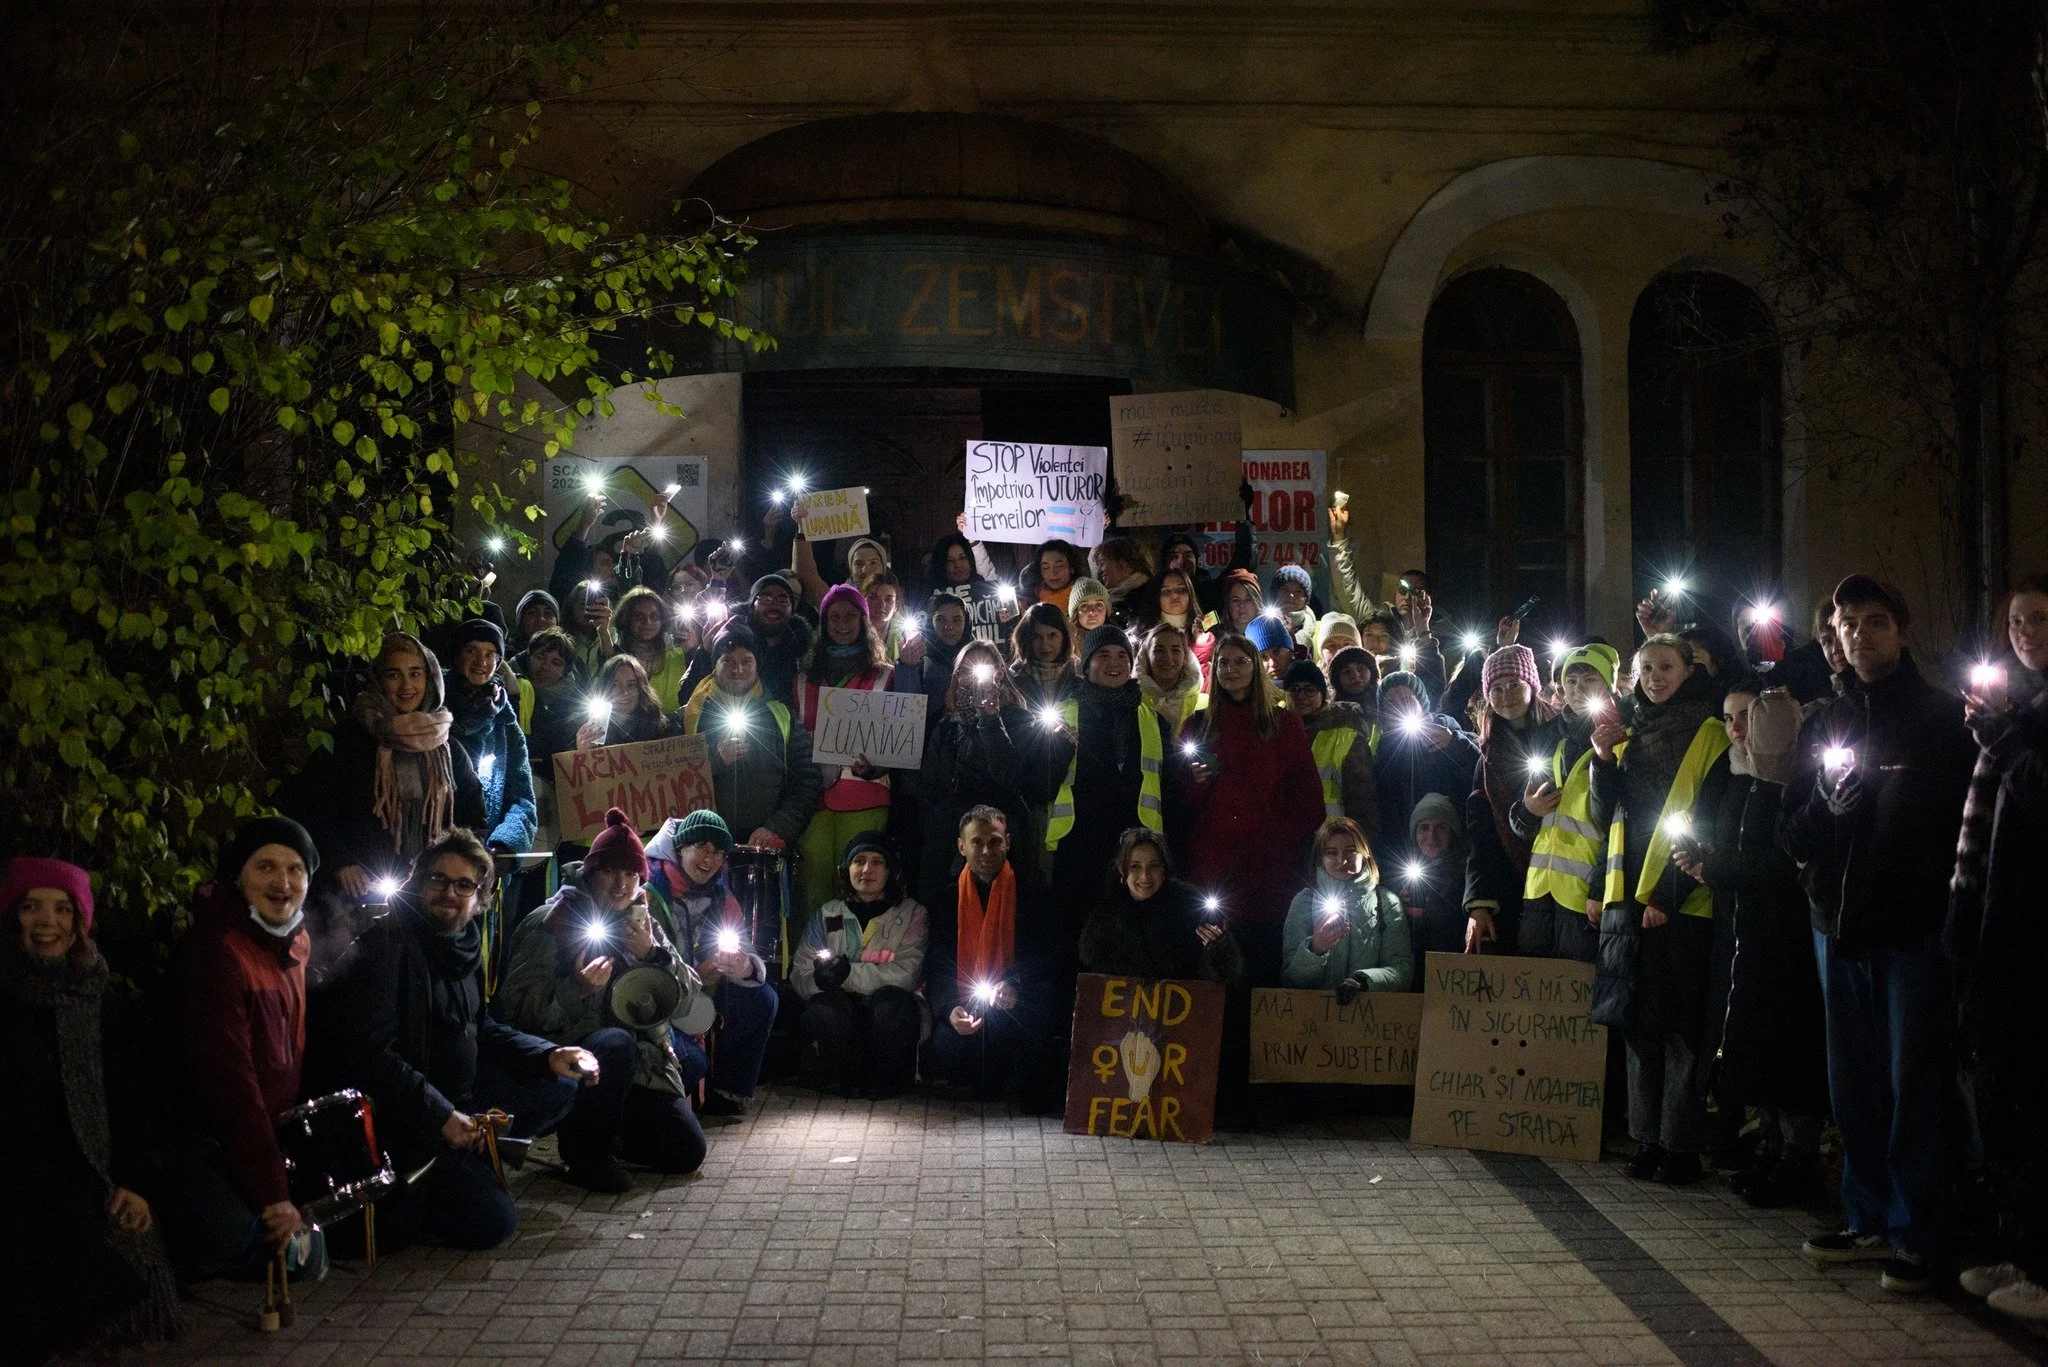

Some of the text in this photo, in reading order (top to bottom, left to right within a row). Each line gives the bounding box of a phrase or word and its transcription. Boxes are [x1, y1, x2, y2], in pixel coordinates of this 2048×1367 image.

[903, 263, 1222, 357] ZEMSTVEI
[971, 442, 1025, 474] STOP
[971, 473, 1104, 508] Împotriva TUTUROR
[968, 501, 1046, 533] Femeilor
[1273, 541, 1295, 566] 44
[1299, 541, 1320, 566] 72
[844, 691, 909, 718] SĂ FIE
[818, 717, 917, 756] LUMINĂ
[555, 748, 639, 789] VREM
[1100, 978, 1193, 1026] END
[1437, 968, 1505, 1003] VREAU
[1511, 970, 1532, 1001] SĂ
[1539, 975, 1564, 1003] MĂ
[1254, 991, 1375, 1024] MĂ TEM
[1450, 1004, 1471, 1032] ÎN
[1263, 1041, 1308, 1066] PRIN
[1429, 1071, 1486, 1099] CHIAR
[1524, 1077, 1600, 1108] NOAPTEA
[1087, 1094, 1186, 1142] FEAR
[1447, 1109, 1578, 1148] PE STRADĂ
